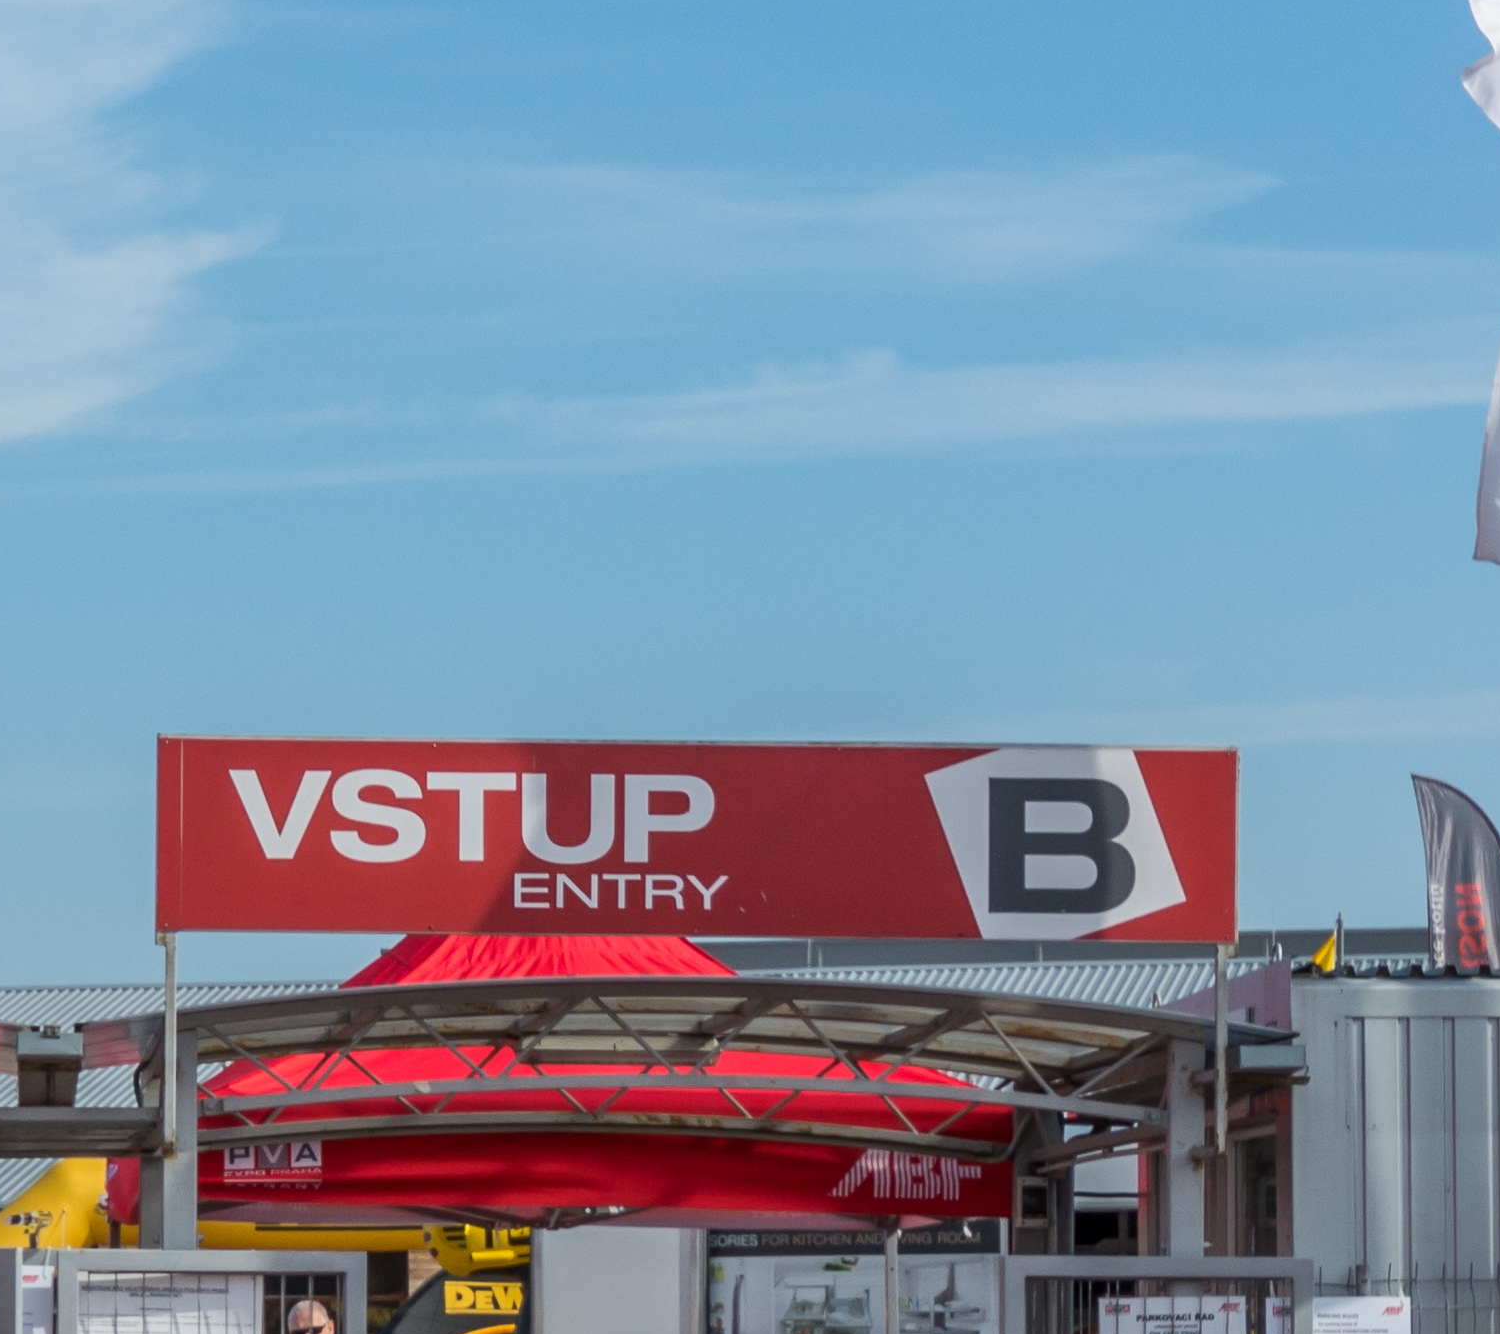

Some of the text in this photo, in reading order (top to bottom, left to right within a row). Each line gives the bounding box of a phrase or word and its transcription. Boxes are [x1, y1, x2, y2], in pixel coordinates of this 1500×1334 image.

[228, 768, 1137, 915] VSTUP B
[513, 872, 729, 912] ENTRY
[230, 1143, 318, 1165] PVA
[762, 1234, 790, 1245] FOR
[792, 1233, 852, 1245] KITCHEN
